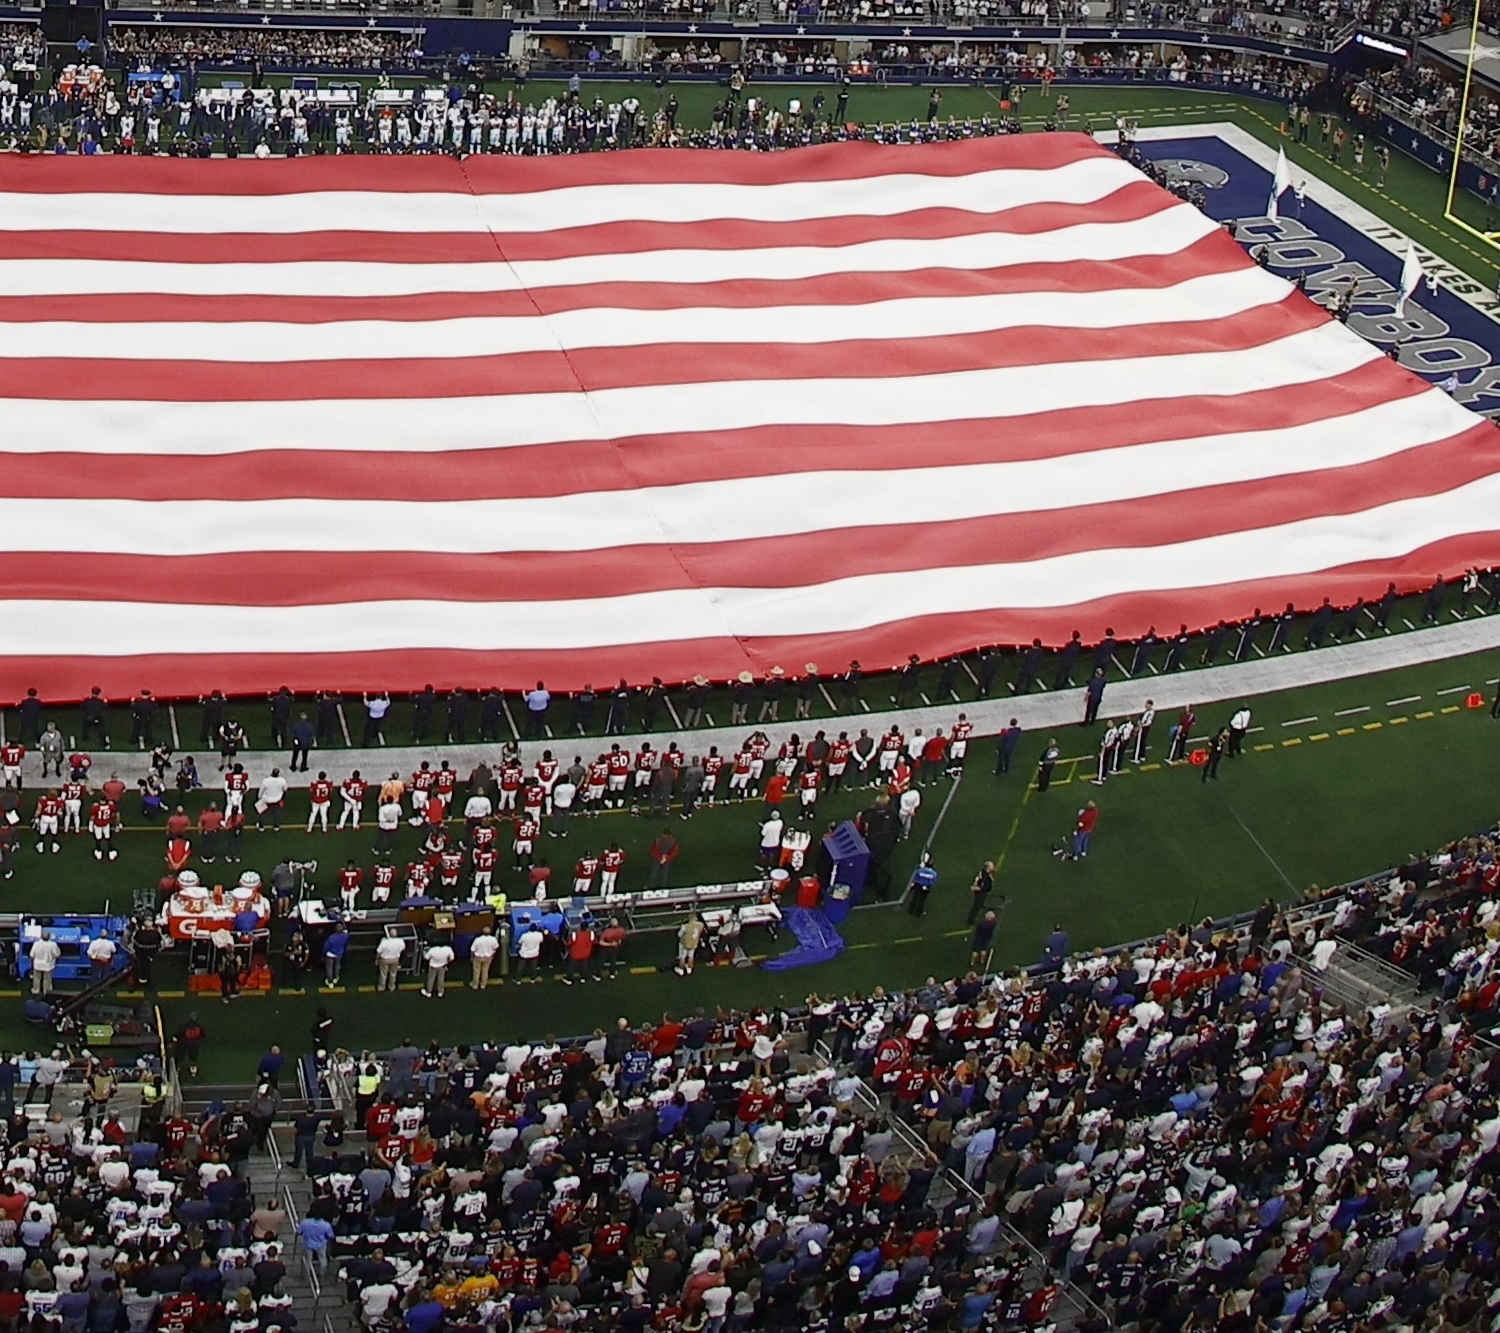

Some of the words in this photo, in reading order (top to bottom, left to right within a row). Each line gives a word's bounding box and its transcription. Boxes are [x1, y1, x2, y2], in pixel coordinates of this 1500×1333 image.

[1365, 225, 1402, 241] IT
[8, 753, 18, 761] 11
[611, 756, 628, 767] 50
[544, 767, 551, 775] 9
[234, 780, 241, 789] 6
[316, 787, 329, 796] 13
[528, 793, 543, 801] 54
[45, 805, 56, 813] 41
[98, 809, 110, 819] 12
[477, 833, 492, 843] 32
[480, 858, 492, 867] 14
[584, 863, 596, 875] 31
[348, 877, 353, 885] 1
[376, 873, 392, 883] 30
[907, 1079, 923, 1090] 12
[403, 1119, 419, 1130] 12
[783, 1139, 796, 1151] 21
[811, 1134, 825, 1146] 21
[385, 1148, 400, 1157] 12
